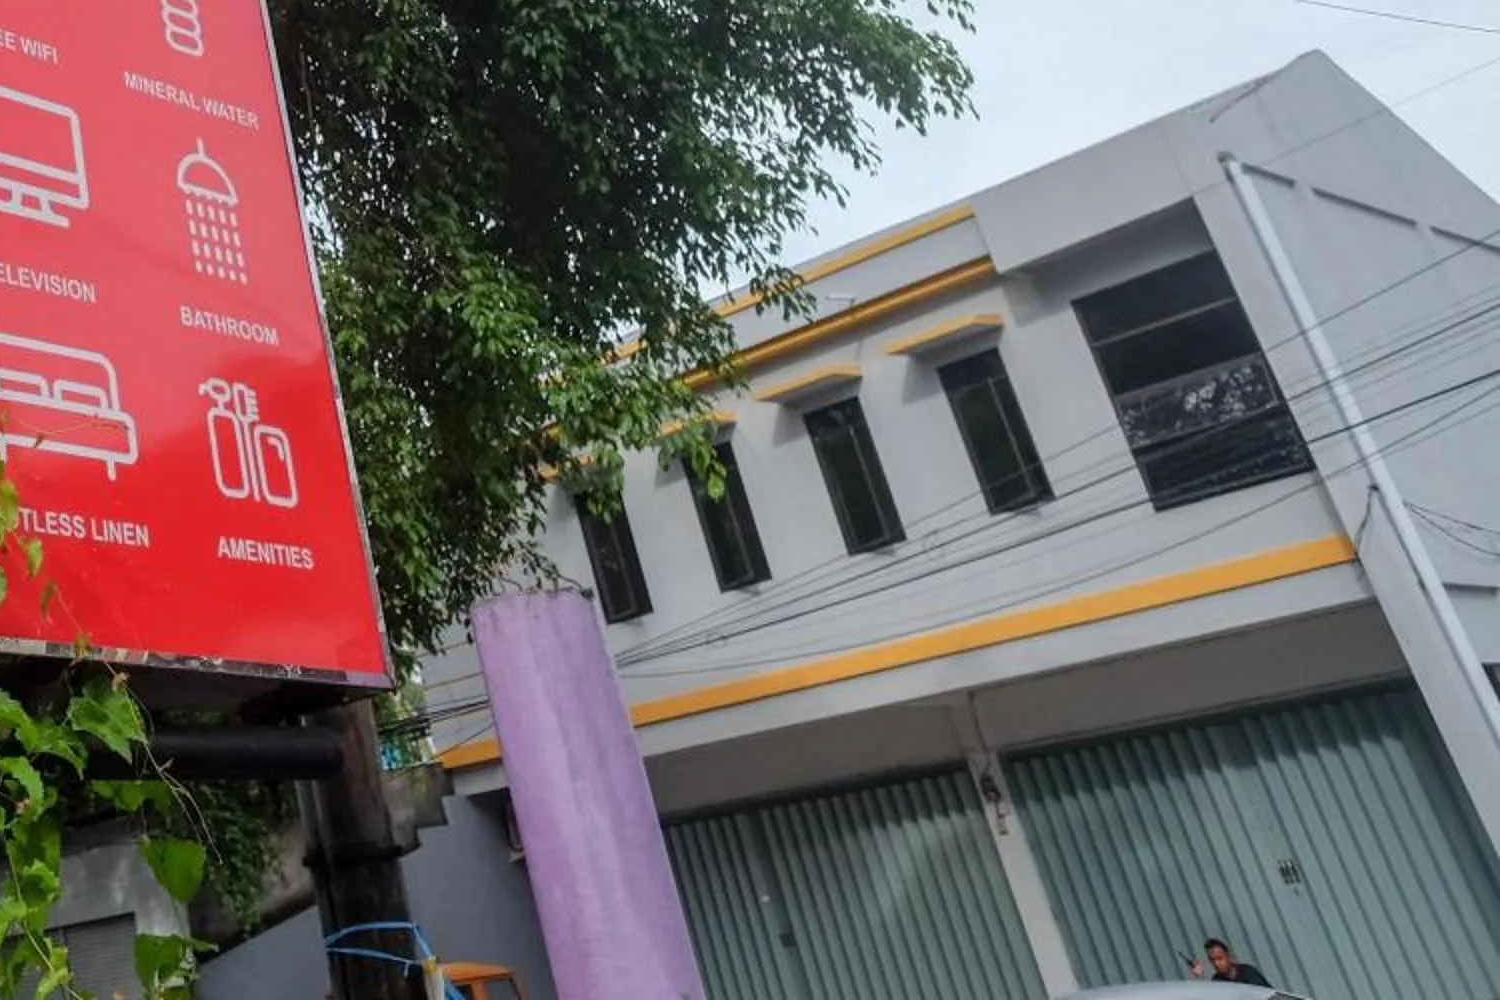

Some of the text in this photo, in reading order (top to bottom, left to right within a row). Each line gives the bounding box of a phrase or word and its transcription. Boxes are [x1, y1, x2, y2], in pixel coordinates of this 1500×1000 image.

[19, 34, 59, 65] WIFI
[123, 71, 260, 130] MINERAL WATER
[179, 305, 280, 347] BATHROOM
[91, 517, 150, 549] LINEN
[217, 535, 315, 571] AMENITIES
